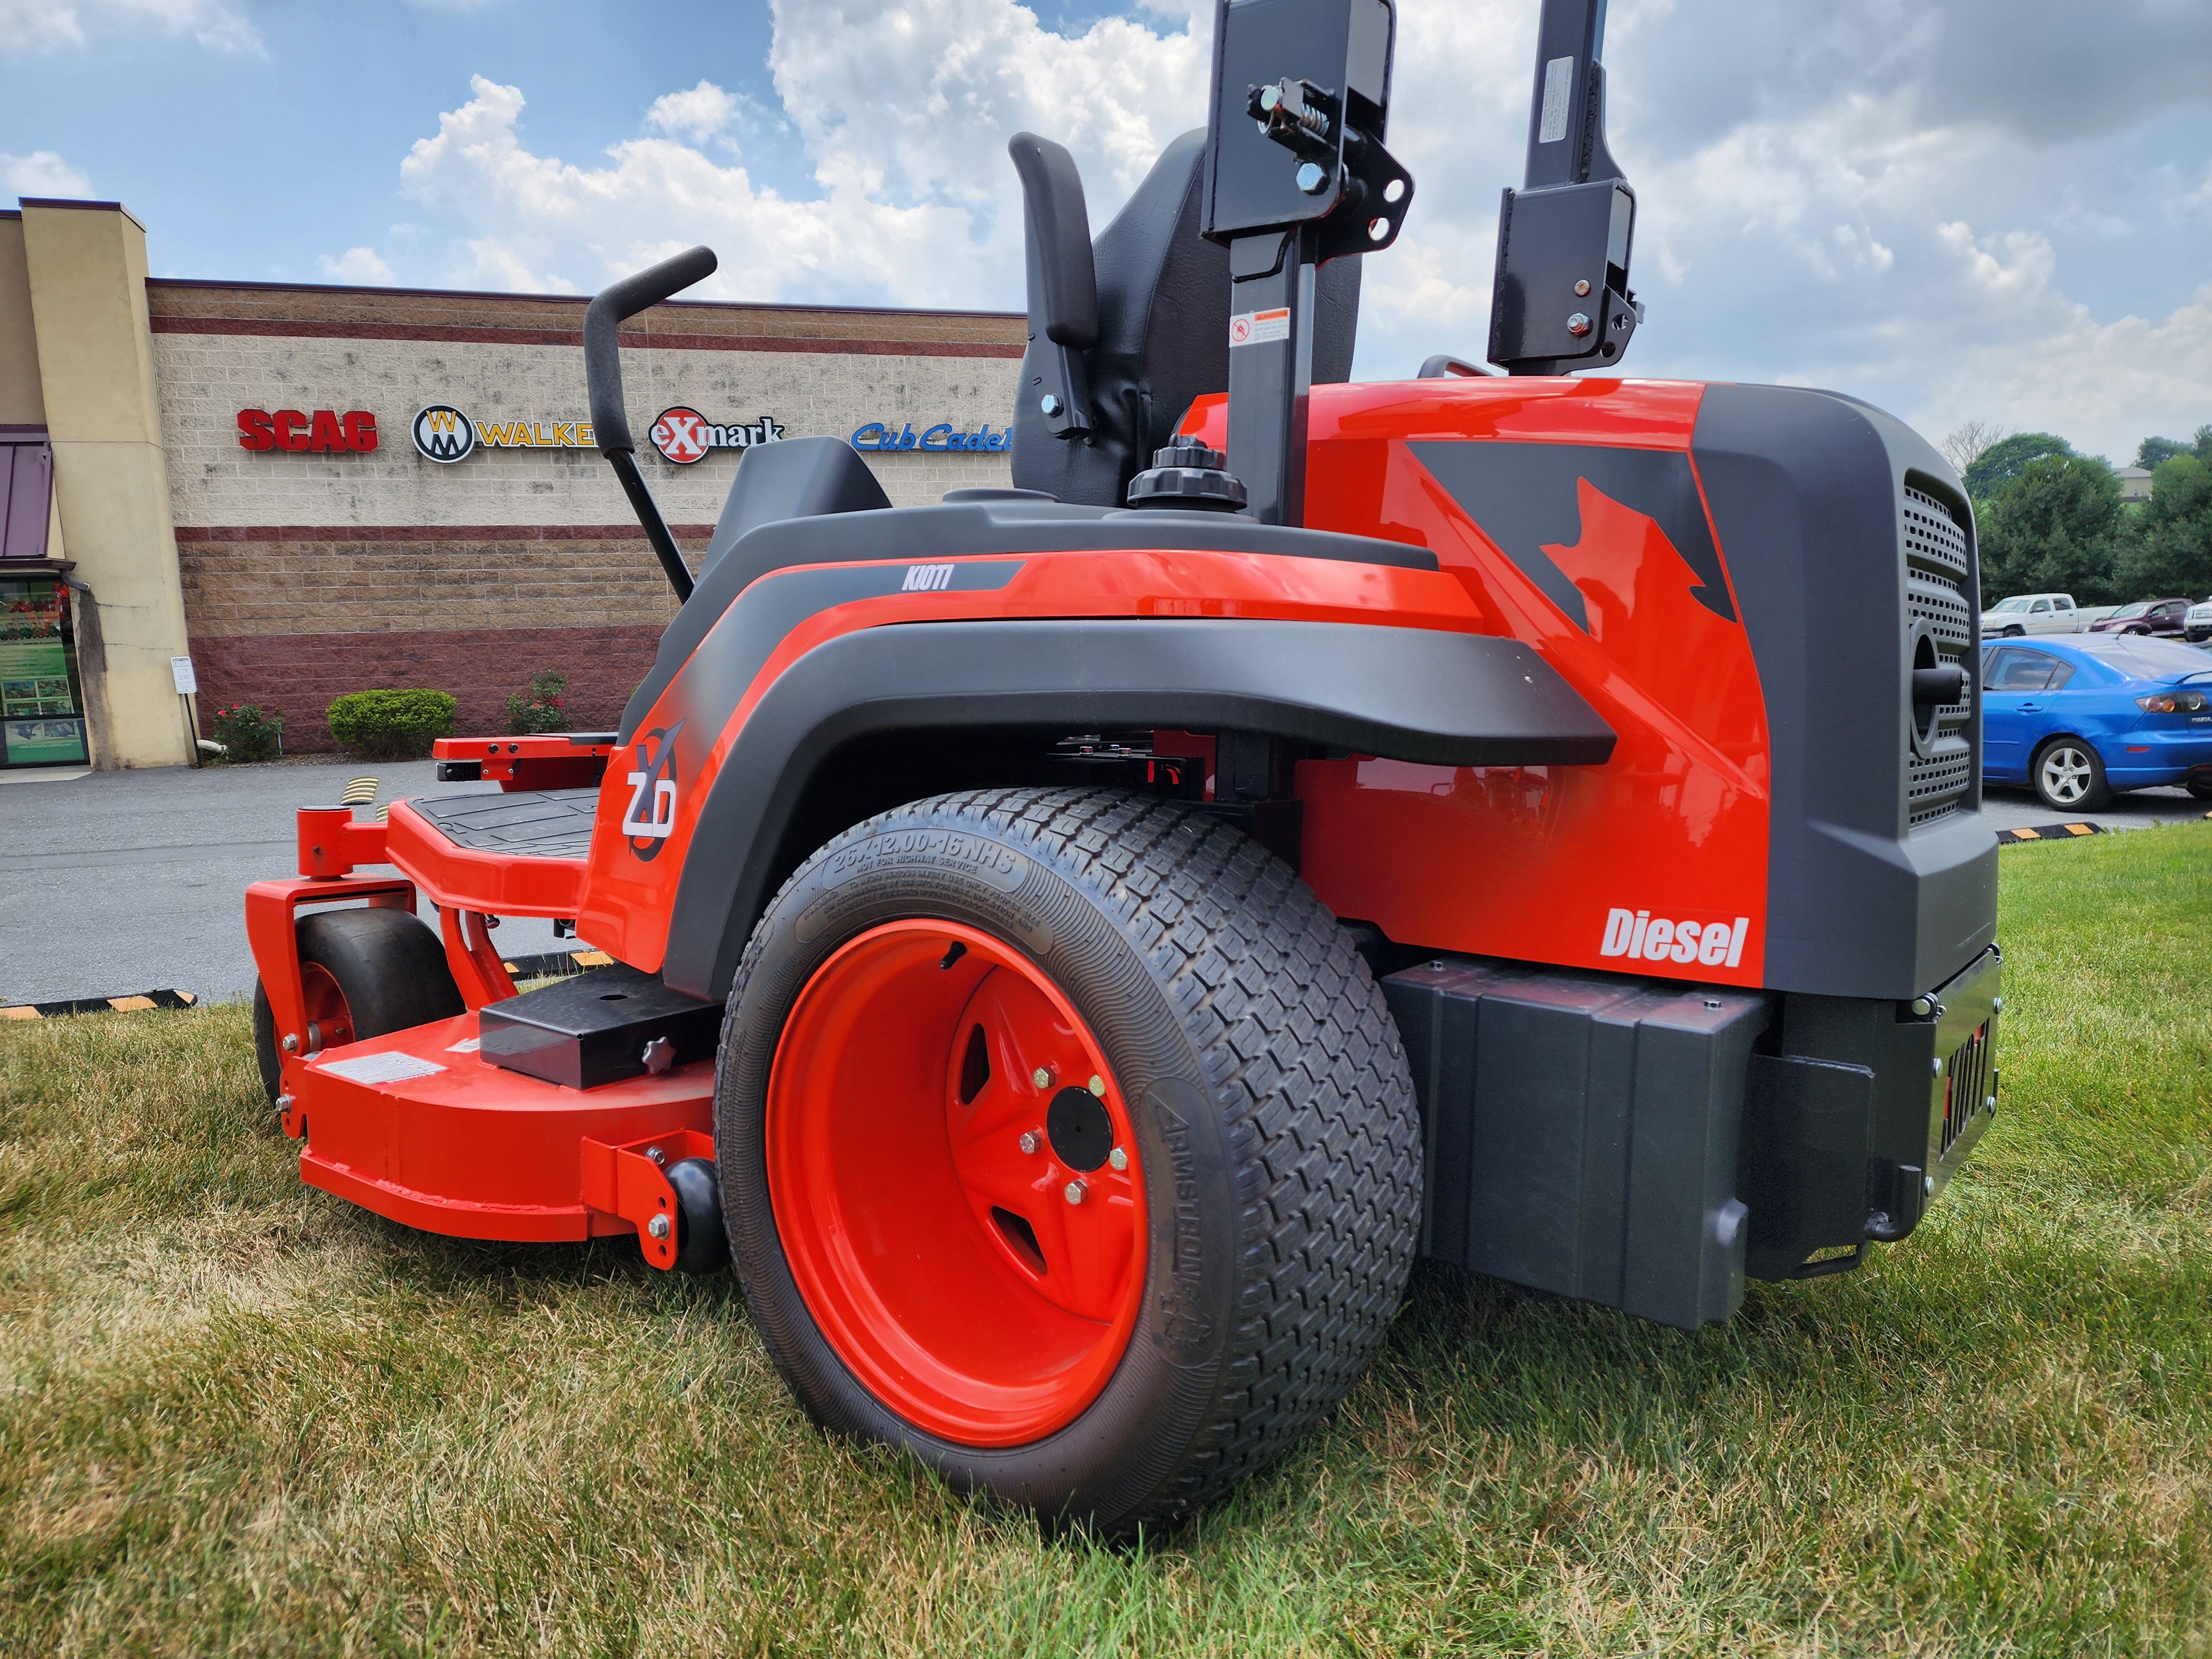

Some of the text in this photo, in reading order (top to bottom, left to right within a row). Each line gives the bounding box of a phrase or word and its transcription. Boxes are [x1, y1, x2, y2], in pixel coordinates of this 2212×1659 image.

[237, 409, 379, 452] SCAG
[474, 421, 599, 447] WALKE
[650, 416, 784, 455] eXmark
[851, 422, 917, 451] Cub
[901, 564, 954, 591] KIOTI
[857, 855, 978, 875] NOT FOR HIGHWAY SERVICE
[963, 838, 1016, 874] NHS
[1600, 907, 1750, 968] Diesel
